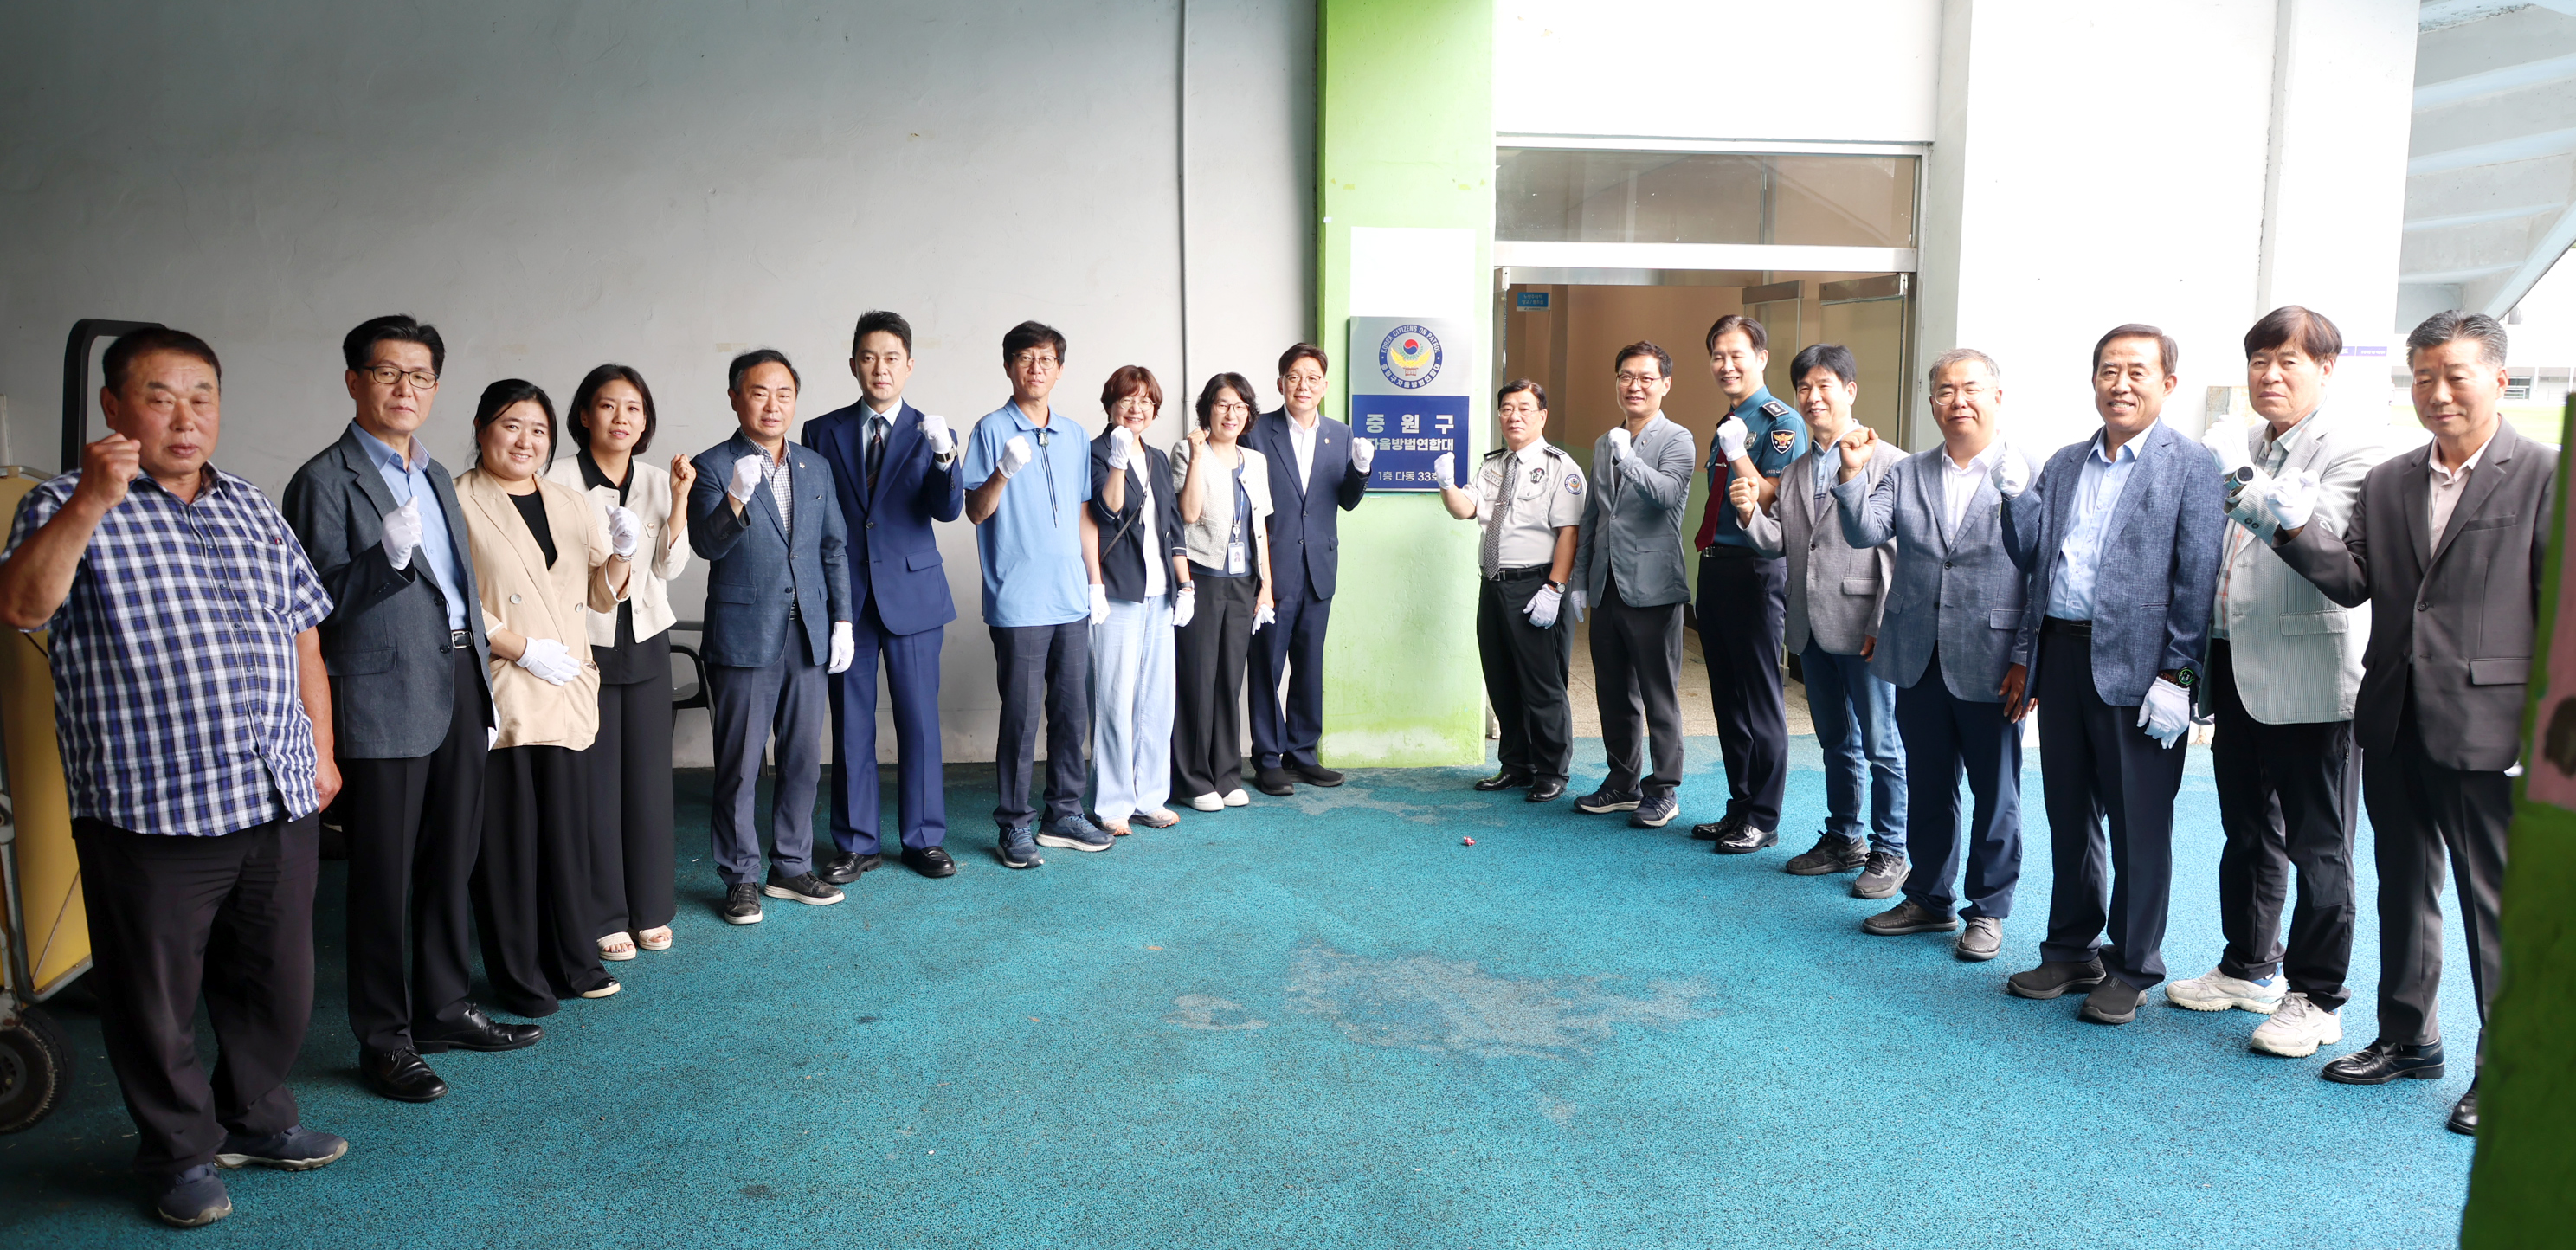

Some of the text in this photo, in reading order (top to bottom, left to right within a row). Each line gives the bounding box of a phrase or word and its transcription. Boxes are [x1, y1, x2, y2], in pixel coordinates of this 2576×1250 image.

[1381, 325, 1441, 353] KOREA CITIZENS ON PATROL
[1378, 471, 1393, 481] 1층
[1395, 471, 1415, 481] 다동
